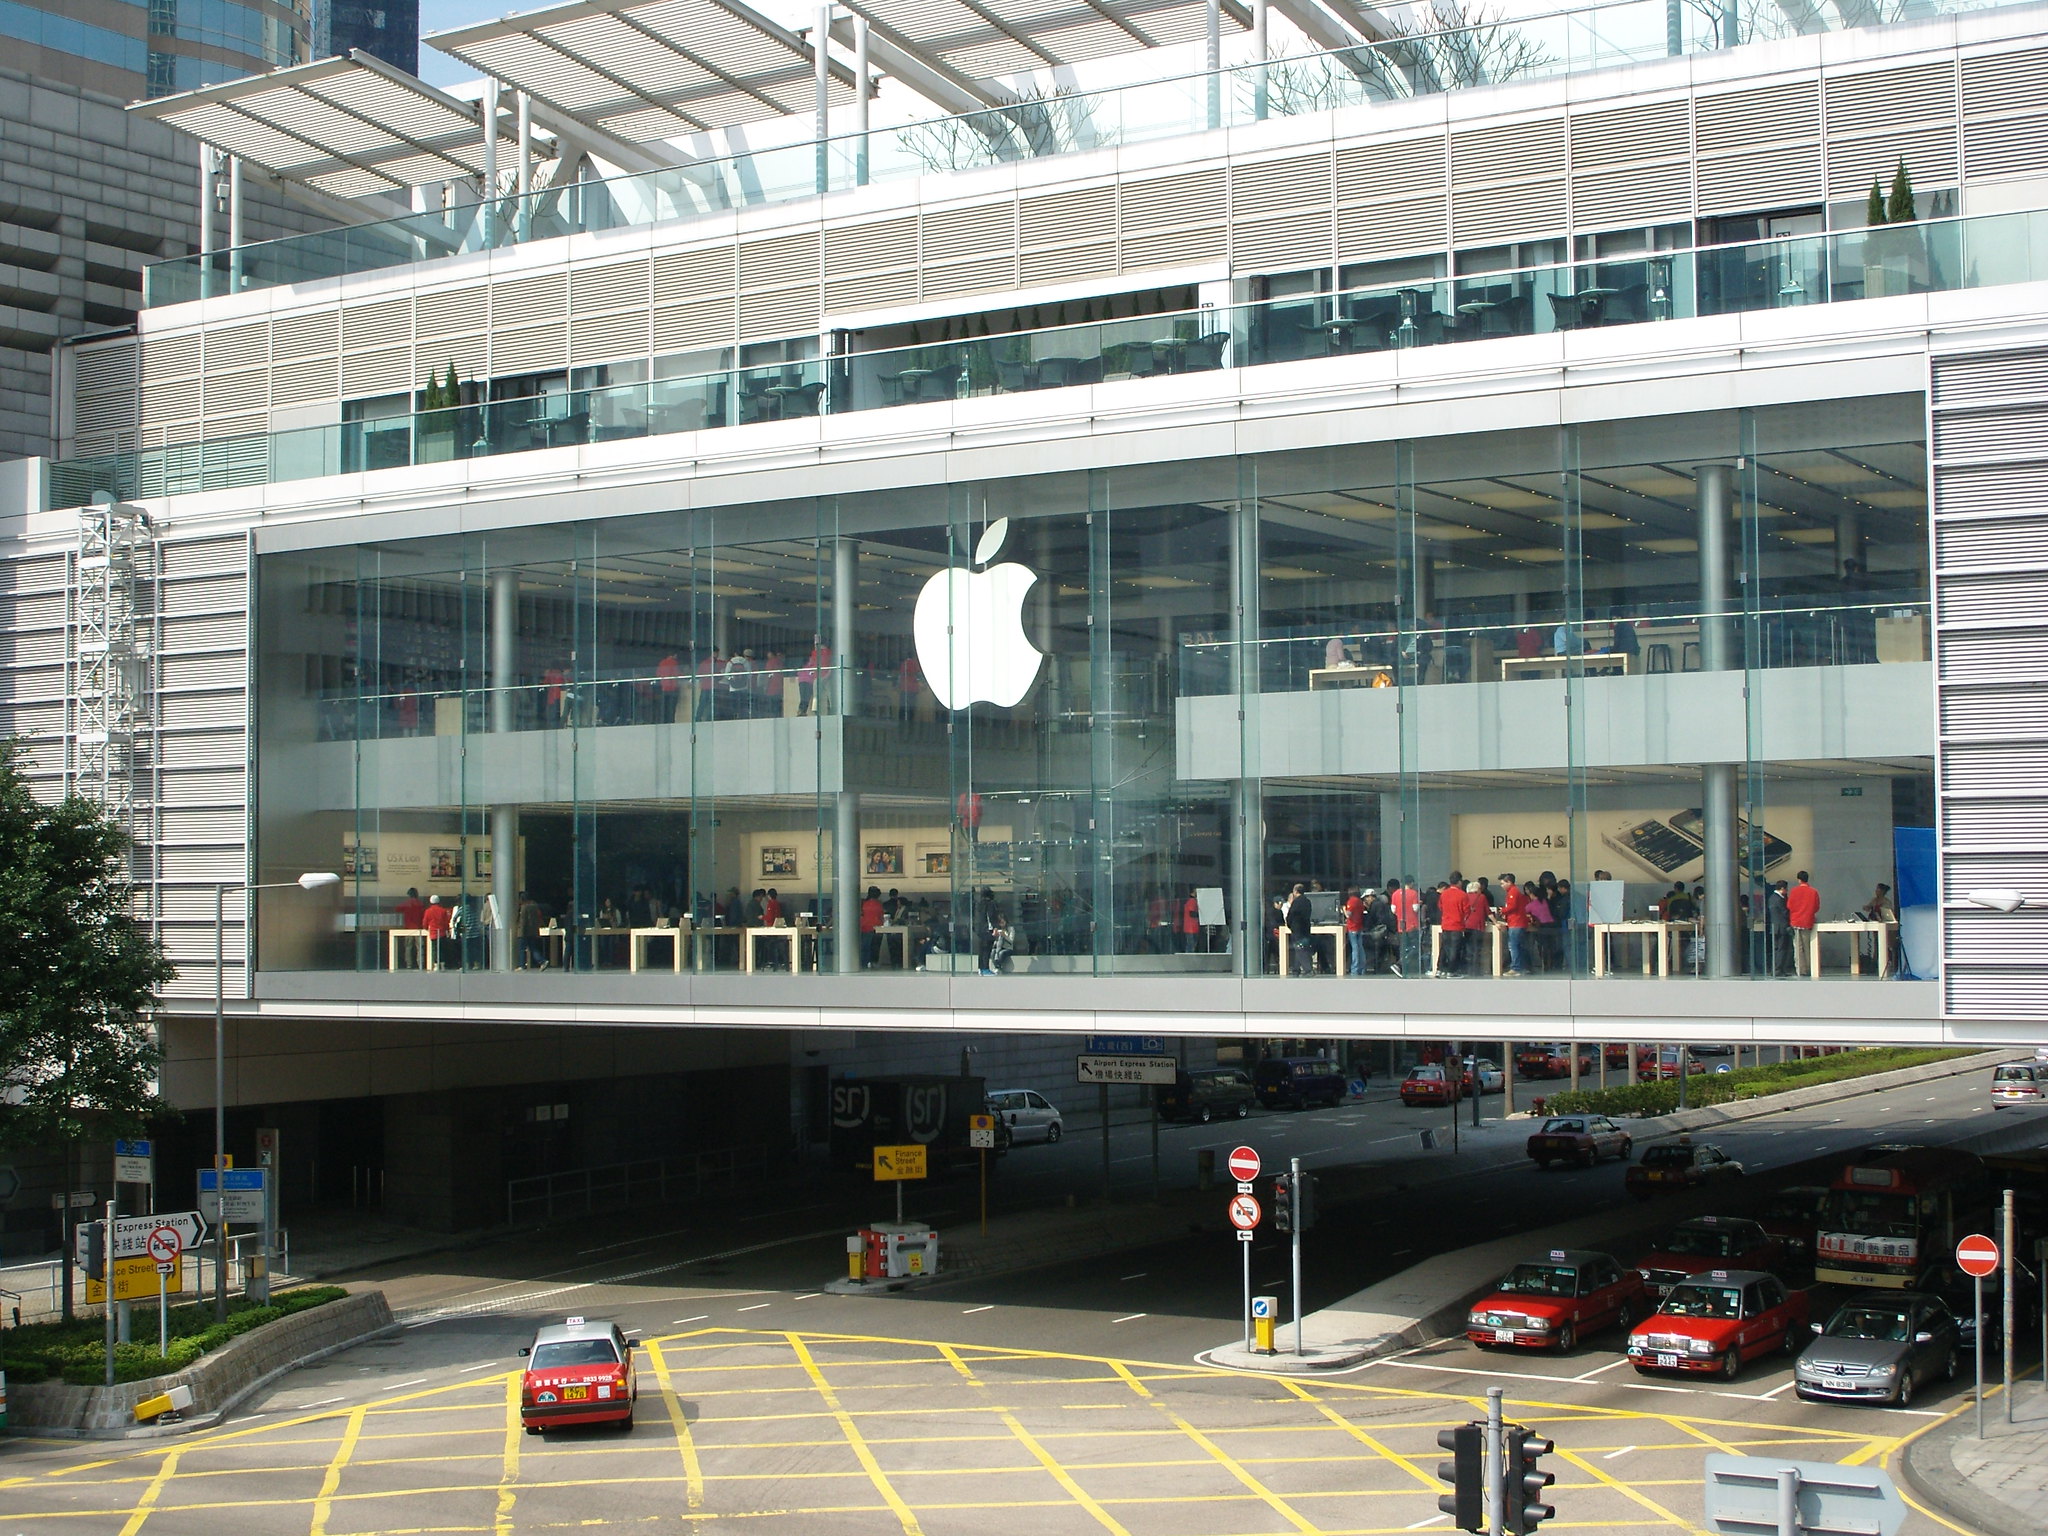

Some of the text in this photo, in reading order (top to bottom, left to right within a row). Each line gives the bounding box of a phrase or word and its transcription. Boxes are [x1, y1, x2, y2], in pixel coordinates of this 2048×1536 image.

[1492, 835, 1540, 849] iPhone
[405, 853, 420, 863] Lion
[1094, 1060, 1174, 1069] Airport Express Station
[895, 1150, 923, 1158] Finance
[895, 1157, 916, 1165] Street
[116, 1217, 188, 1233] Express Station
[128, 1263, 155, 1274] Street
[92, 1280, 129, 1297] 金街
